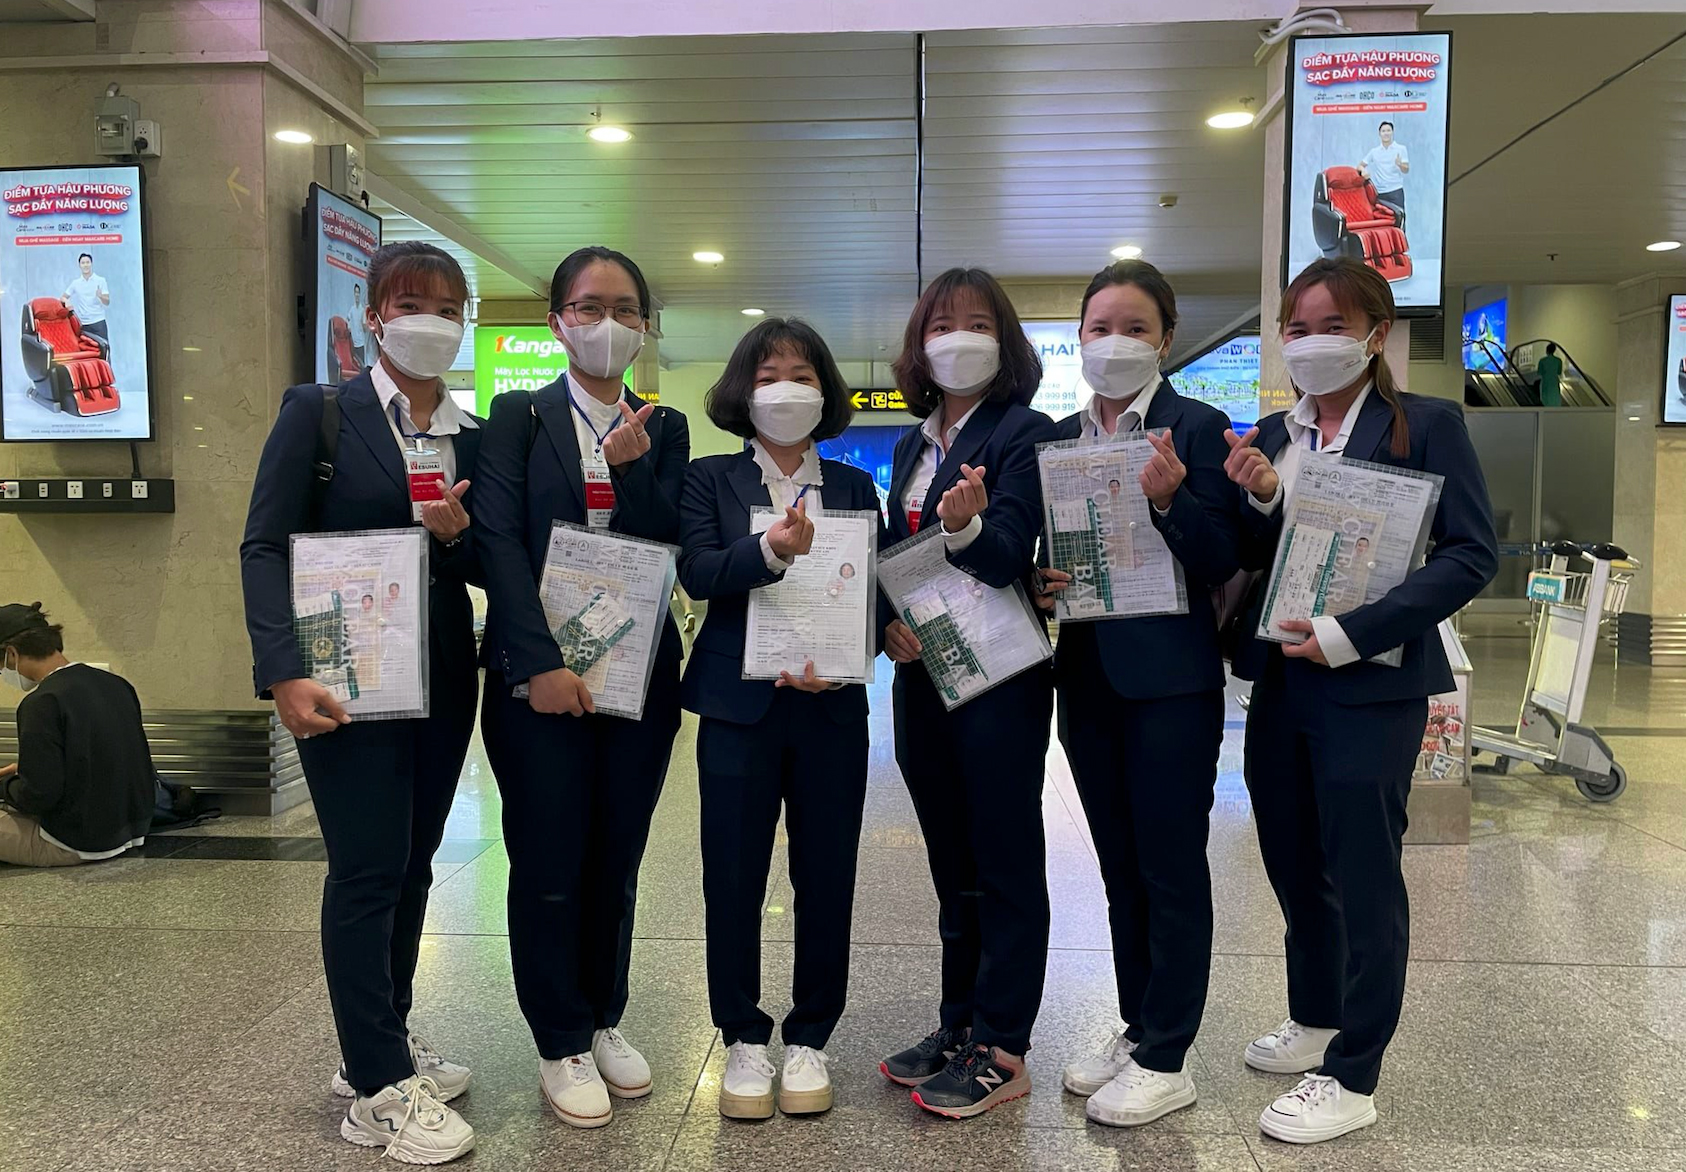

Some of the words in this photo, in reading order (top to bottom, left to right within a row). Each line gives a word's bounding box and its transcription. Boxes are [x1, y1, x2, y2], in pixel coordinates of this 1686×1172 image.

[1389, 52, 1440, 64] PHƯƠNG
[1358, 65, 1392, 78] NĂNG
[1395, 67, 1436, 80] LƯỢNG
[83, 184, 131, 196] PHƯƠNG
[56, 198, 87, 209] NĂNG
[90, 199, 128, 212] LƯỢNG
[495, 335, 567, 357] 1Kanga
